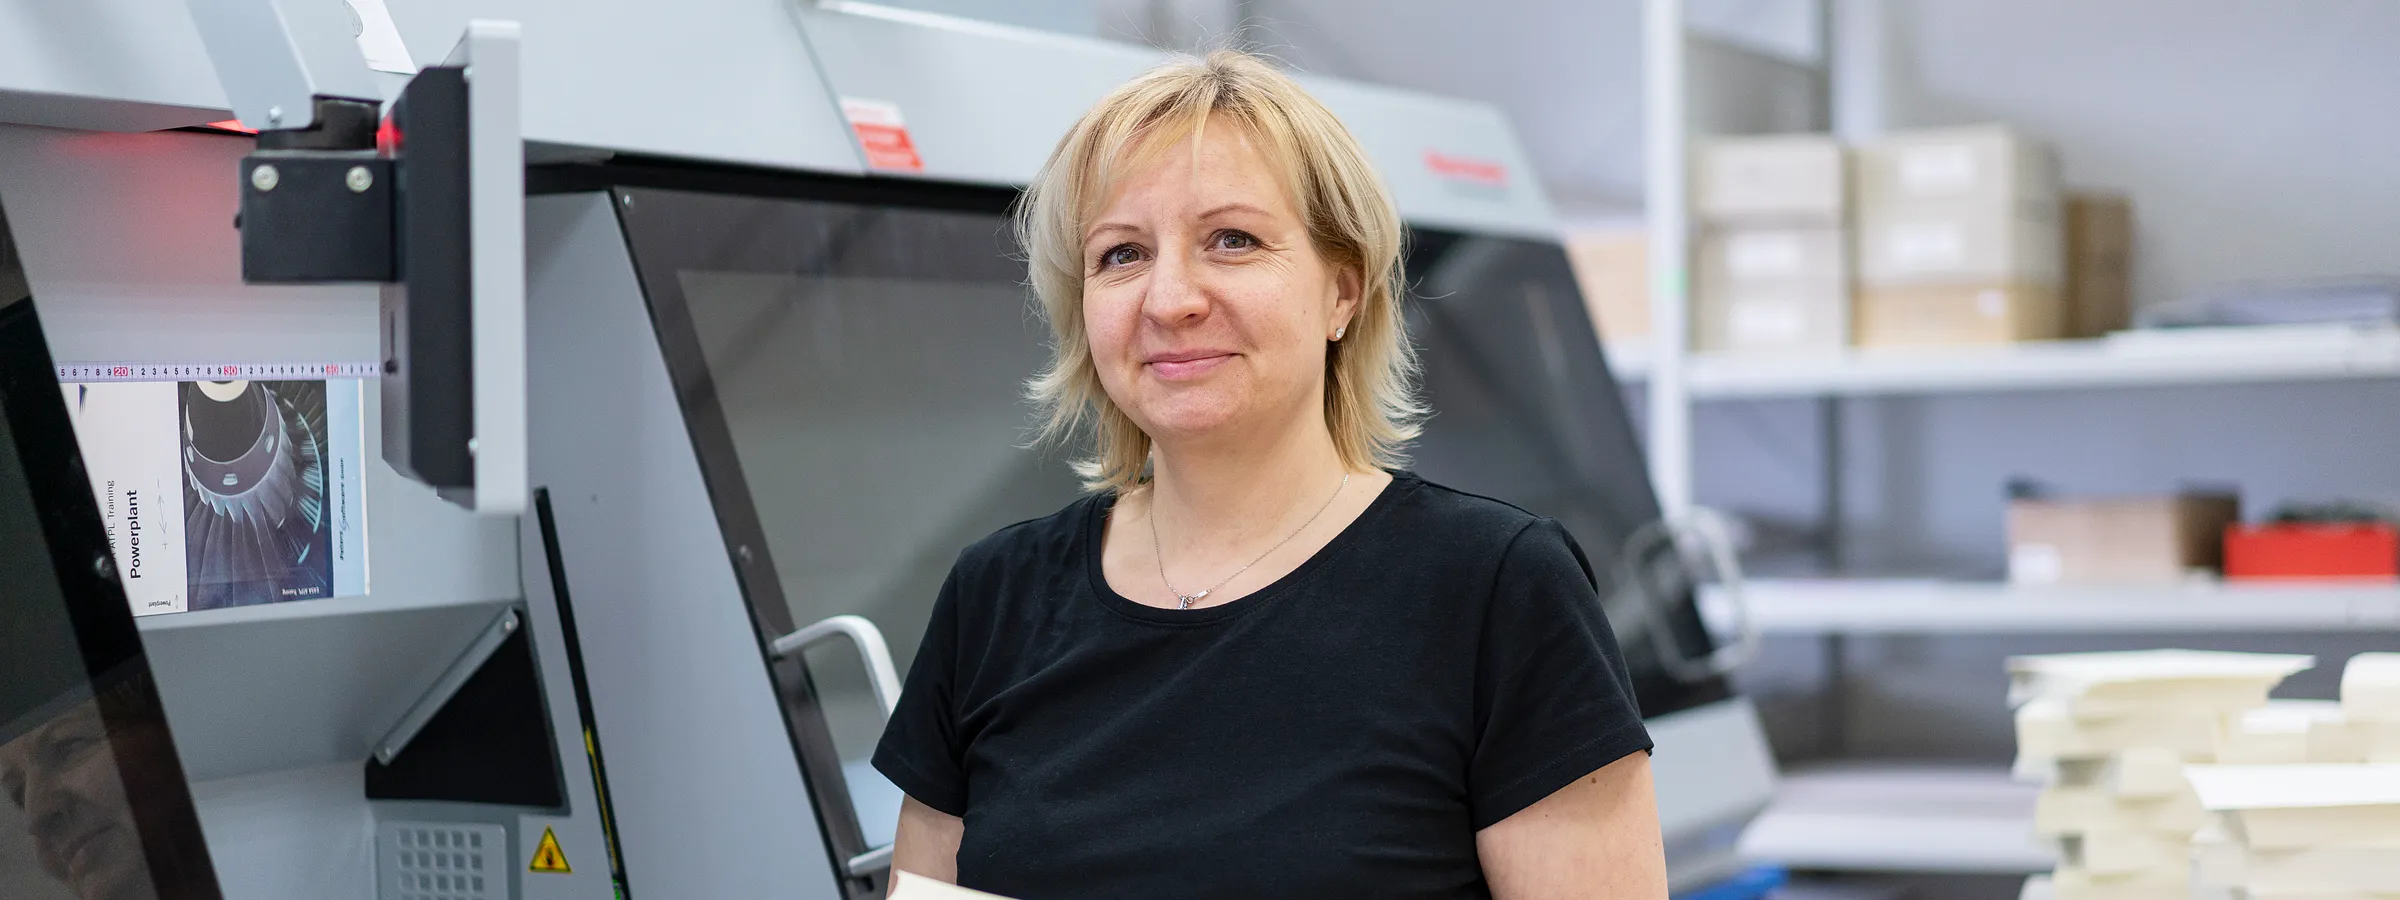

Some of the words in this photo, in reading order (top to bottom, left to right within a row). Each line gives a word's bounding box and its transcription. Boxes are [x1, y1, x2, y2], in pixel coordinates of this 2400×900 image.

[114, 367, 128, 376] 20
[107, 480, 115, 519] Training
[107, 523, 116, 549] ATPL
[126, 490, 141, 579] Powerplant
[148, 600, 171, 608] Powerplant
